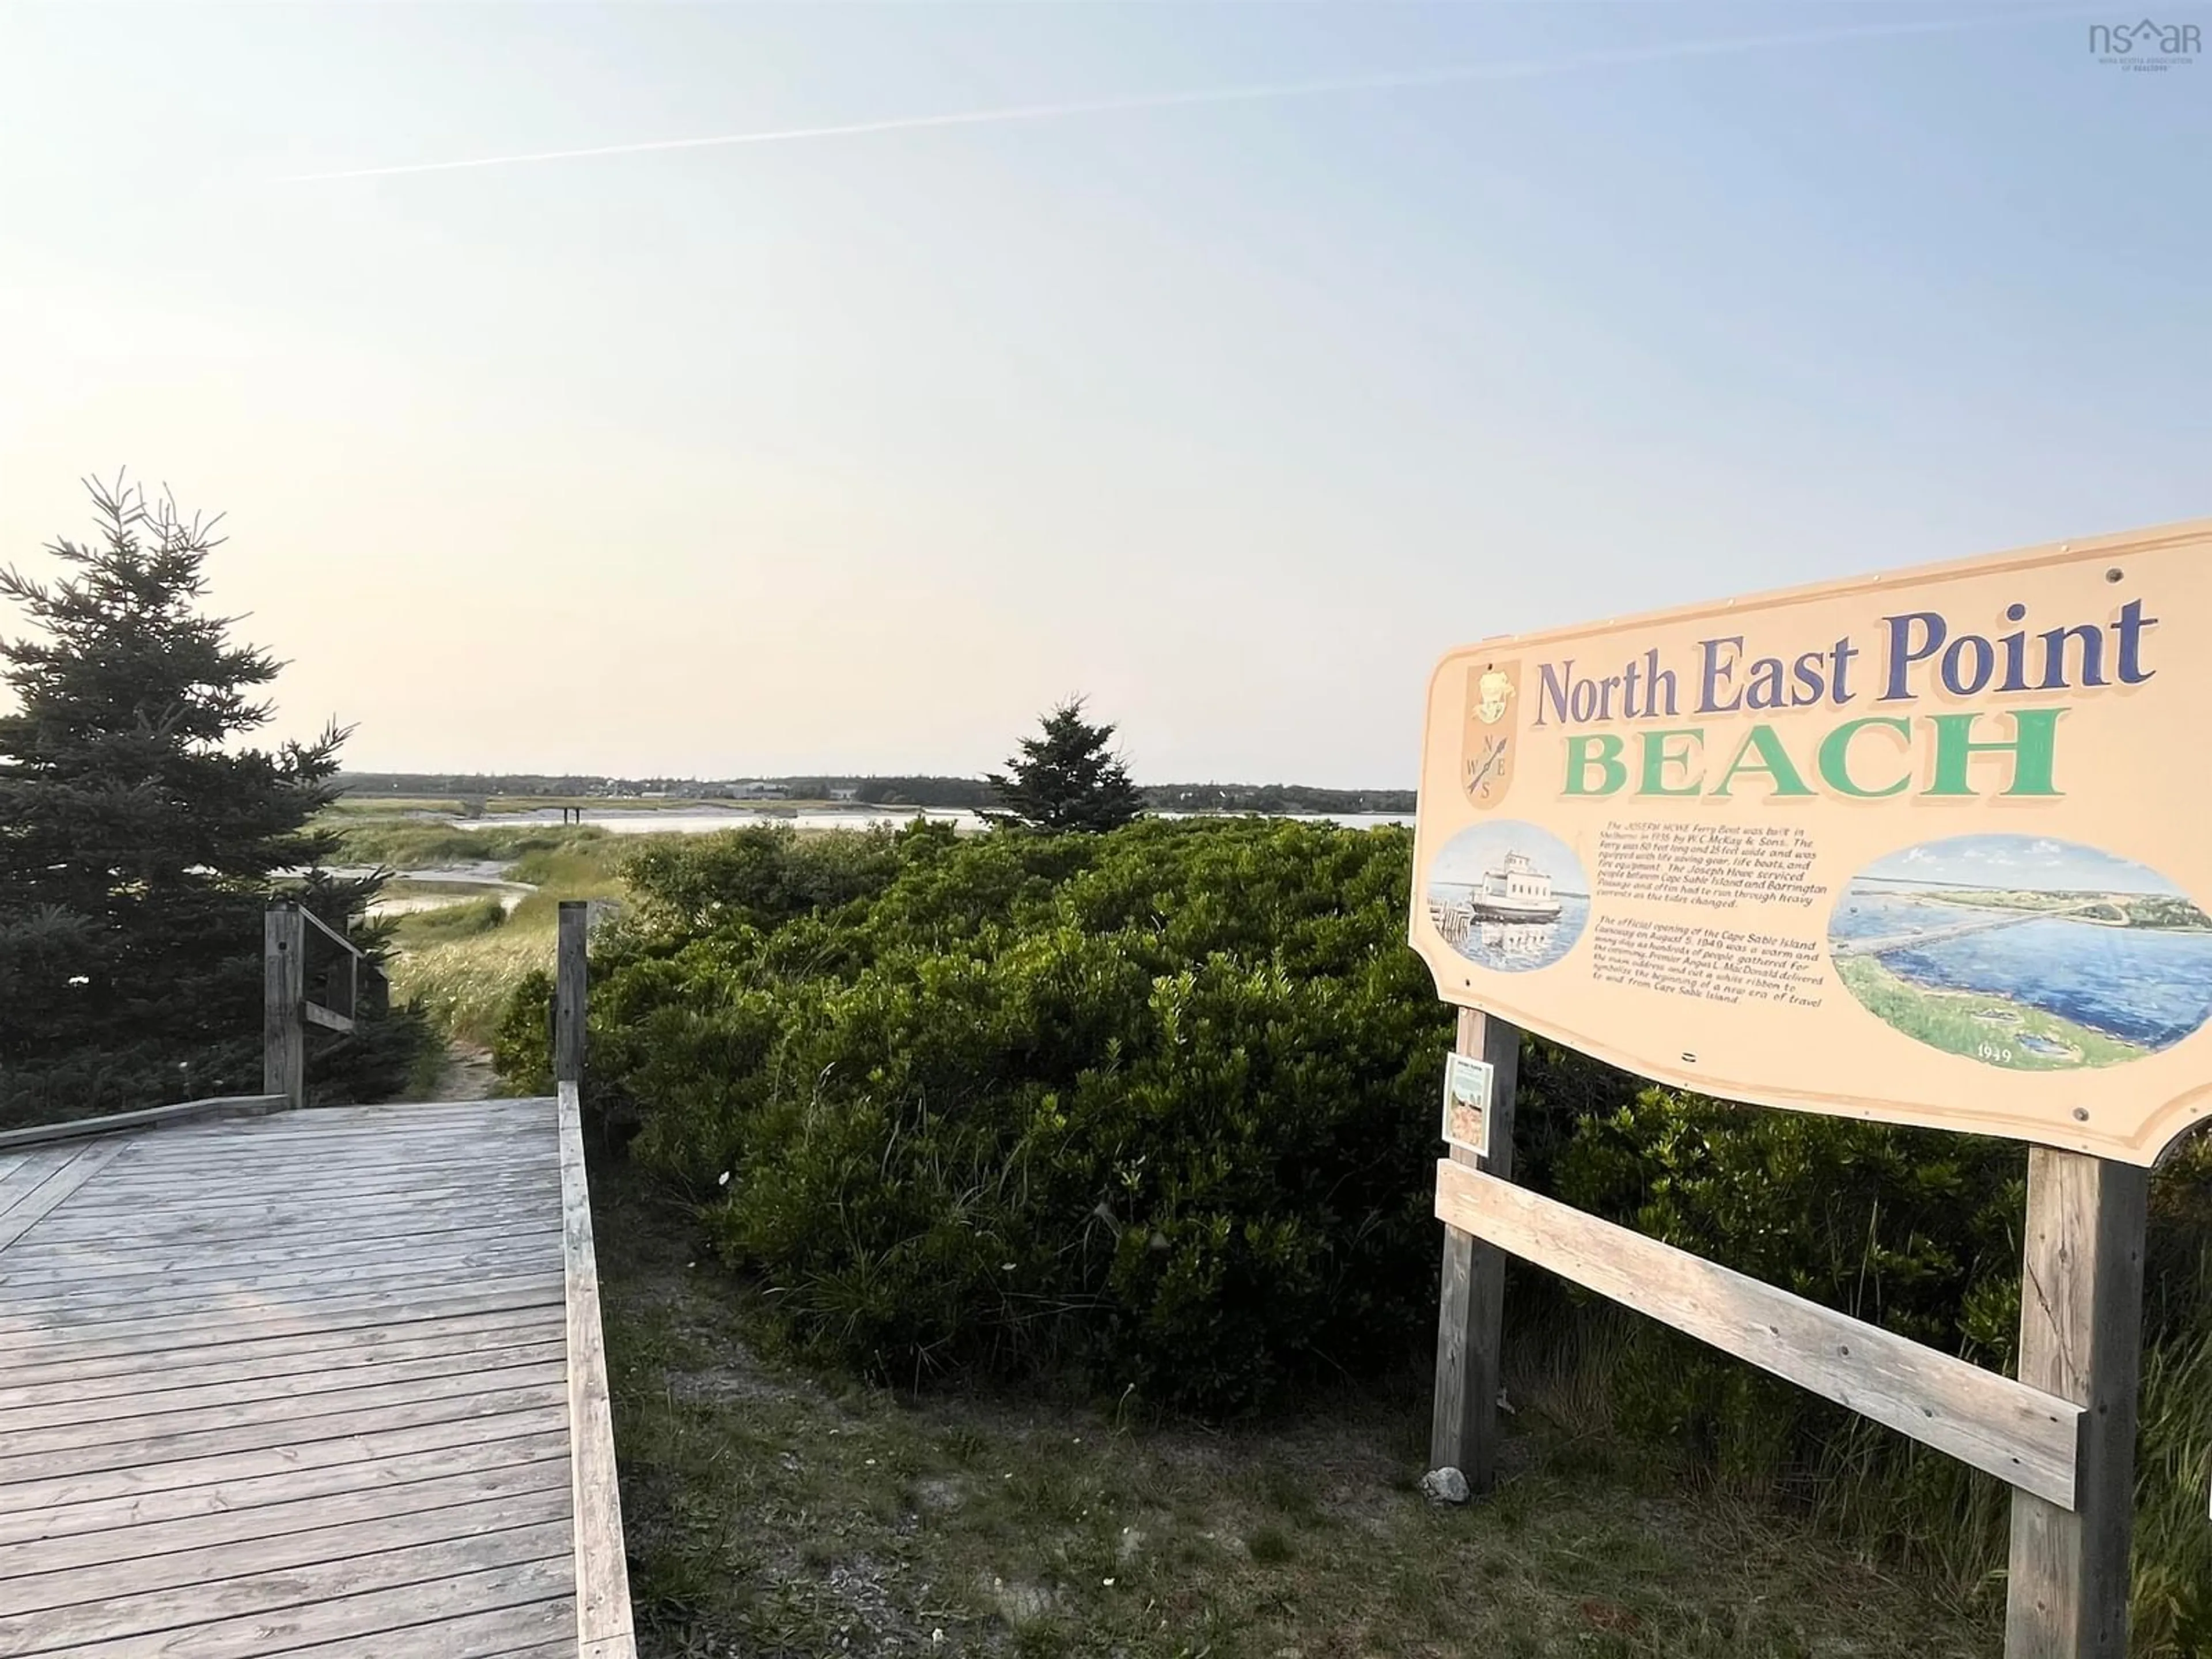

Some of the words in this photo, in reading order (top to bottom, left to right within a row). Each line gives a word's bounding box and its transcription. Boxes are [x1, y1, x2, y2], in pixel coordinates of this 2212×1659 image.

[1535, 648, 1680, 726] North
[1694, 635, 1859, 714] East
[1876, 598, 2159, 701] Point
[1560, 707, 2072, 797] BEACH
[1467, 758, 1479, 775] W
[1497, 759, 1505, 776] E
[1482, 782, 1490, 799] S
[1743, 827, 1763, 835] was
[1794, 828, 1804, 836] in
[1673, 833, 1685, 843] by
[1746, 836, 1755, 846] &
[1794, 838, 1813, 849] The
[1690, 845, 1709, 854] and
[1770, 849, 1793, 858] and
[1795, 851, 1817, 860] was
[1668, 863, 1685, 873] The
[1688, 865, 1724, 876] Joseph
[1728, 868, 1753, 878] Howe
[1757, 871, 1805, 881] serviced
[1733, 857, 1752, 867] life
[1787, 861, 1811, 870] and
[1711, 877, 1743, 887] Island
[1744, 880, 1766, 889] and
[1767, 881, 1827, 895] Barrington
[1647, 892, 1663, 901] the
[1734, 890, 1777, 903] through
[1778, 893, 1813, 907] heavy
[1600, 915, 1616, 925] The
[1691, 927, 1703, 935] of
[1705, 929, 1719, 938] the
[1721, 930, 1746, 942] Cape
[1747, 933, 1778, 946] Sable
[1780, 937, 1817, 950] Island
[1636, 931, 1648, 939] on
[1649, 931, 1683, 943] August
[1726, 944, 1747, 952] was
[1761, 949, 1793, 959] warm
[1796, 951, 1820, 961] and
[1682, 957, 1711, 969] Angus
[1692, 948, 1703, 956] of
[1702, 951, 1734, 961] people
[1737, 955, 1787, 968] gathered
[1790, 960, 1809, 971] for
[1628, 978, 1651, 988] from
[1654, 981, 1675, 993] Cape
[1635, 969, 1649, 978] the
[1700, 980, 1711, 988] of
[1748, 988, 1768, 999] era
[1774, 993, 1787, 1002] of
[1789, 994, 1823, 1007] travel
[1668, 966, 1687, 975] and
[1745, 978, 1780, 990] ribbon
[1784, 983, 1796, 992] to
